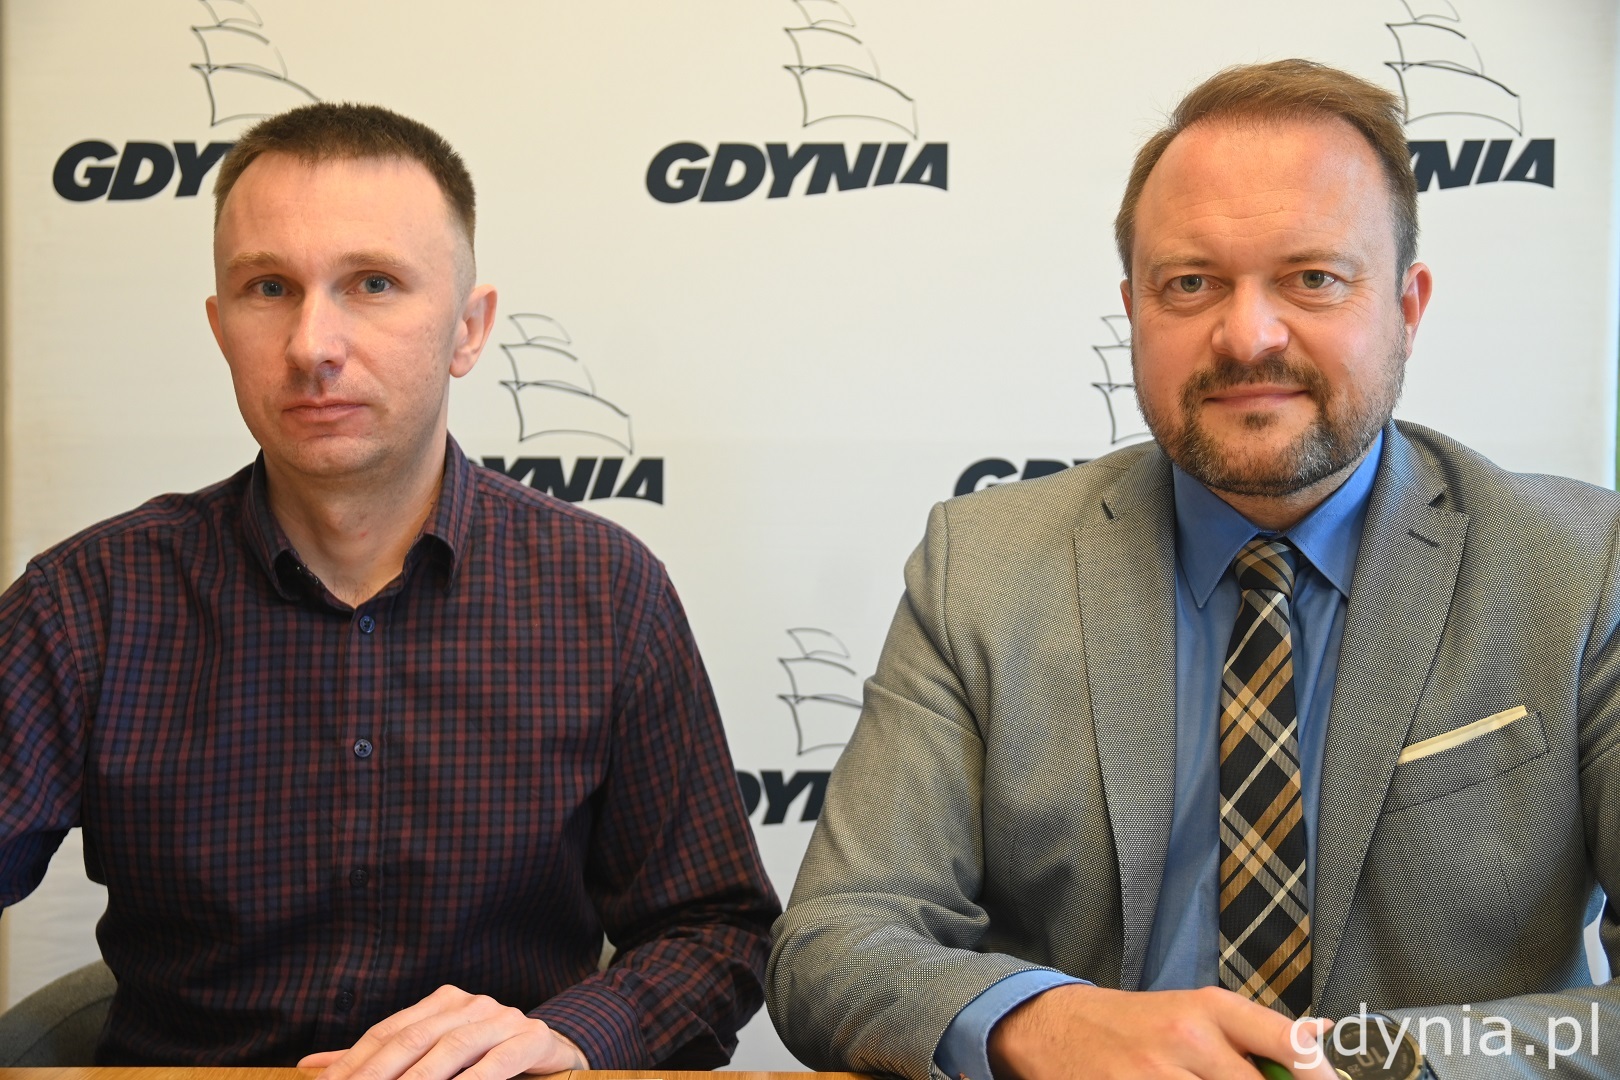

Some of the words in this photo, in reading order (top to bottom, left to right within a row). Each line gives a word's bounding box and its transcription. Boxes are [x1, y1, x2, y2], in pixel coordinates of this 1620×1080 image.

[53, 139, 234, 203] GDY
[645, 140, 949, 204] GDYNIA
[1407, 138, 1555, 193] NIA
[469, 456, 664, 506] NIA
